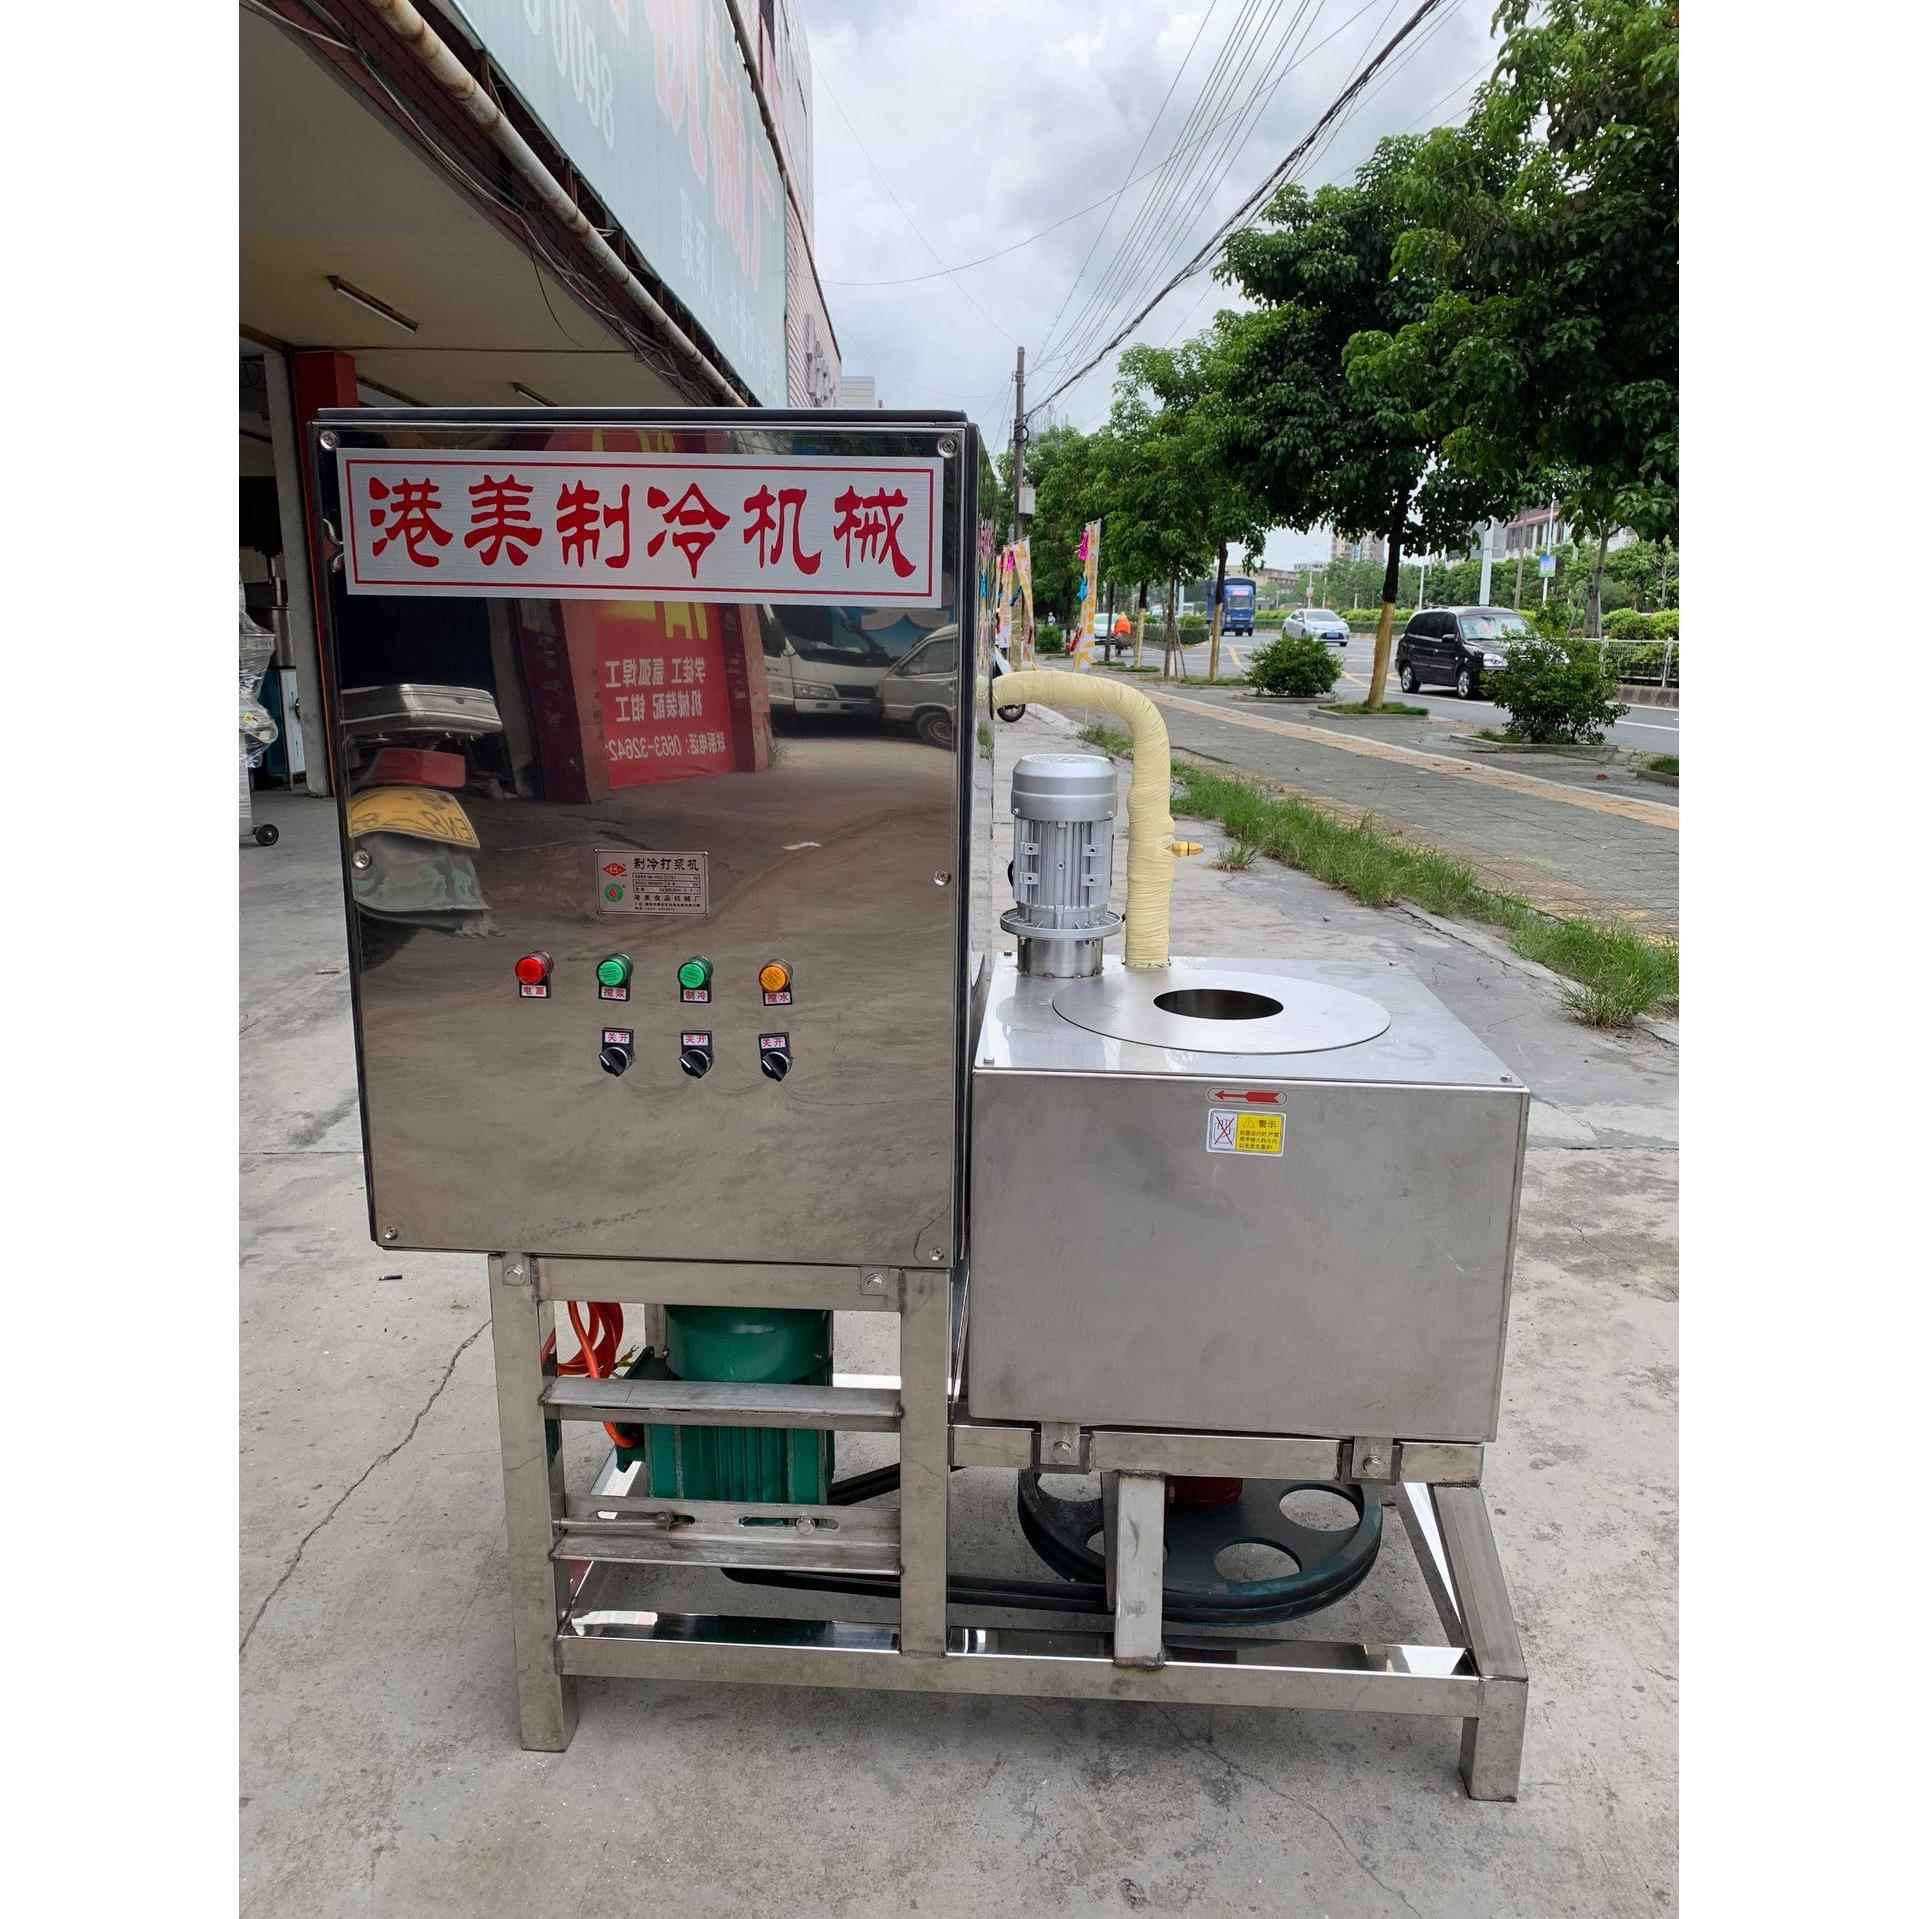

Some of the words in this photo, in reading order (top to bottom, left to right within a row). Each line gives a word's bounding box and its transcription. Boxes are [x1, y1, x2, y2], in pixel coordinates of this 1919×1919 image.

[368, 474, 917, 578] 港美制冷机械
[633, 857, 700, 872] 制冷打浆机
